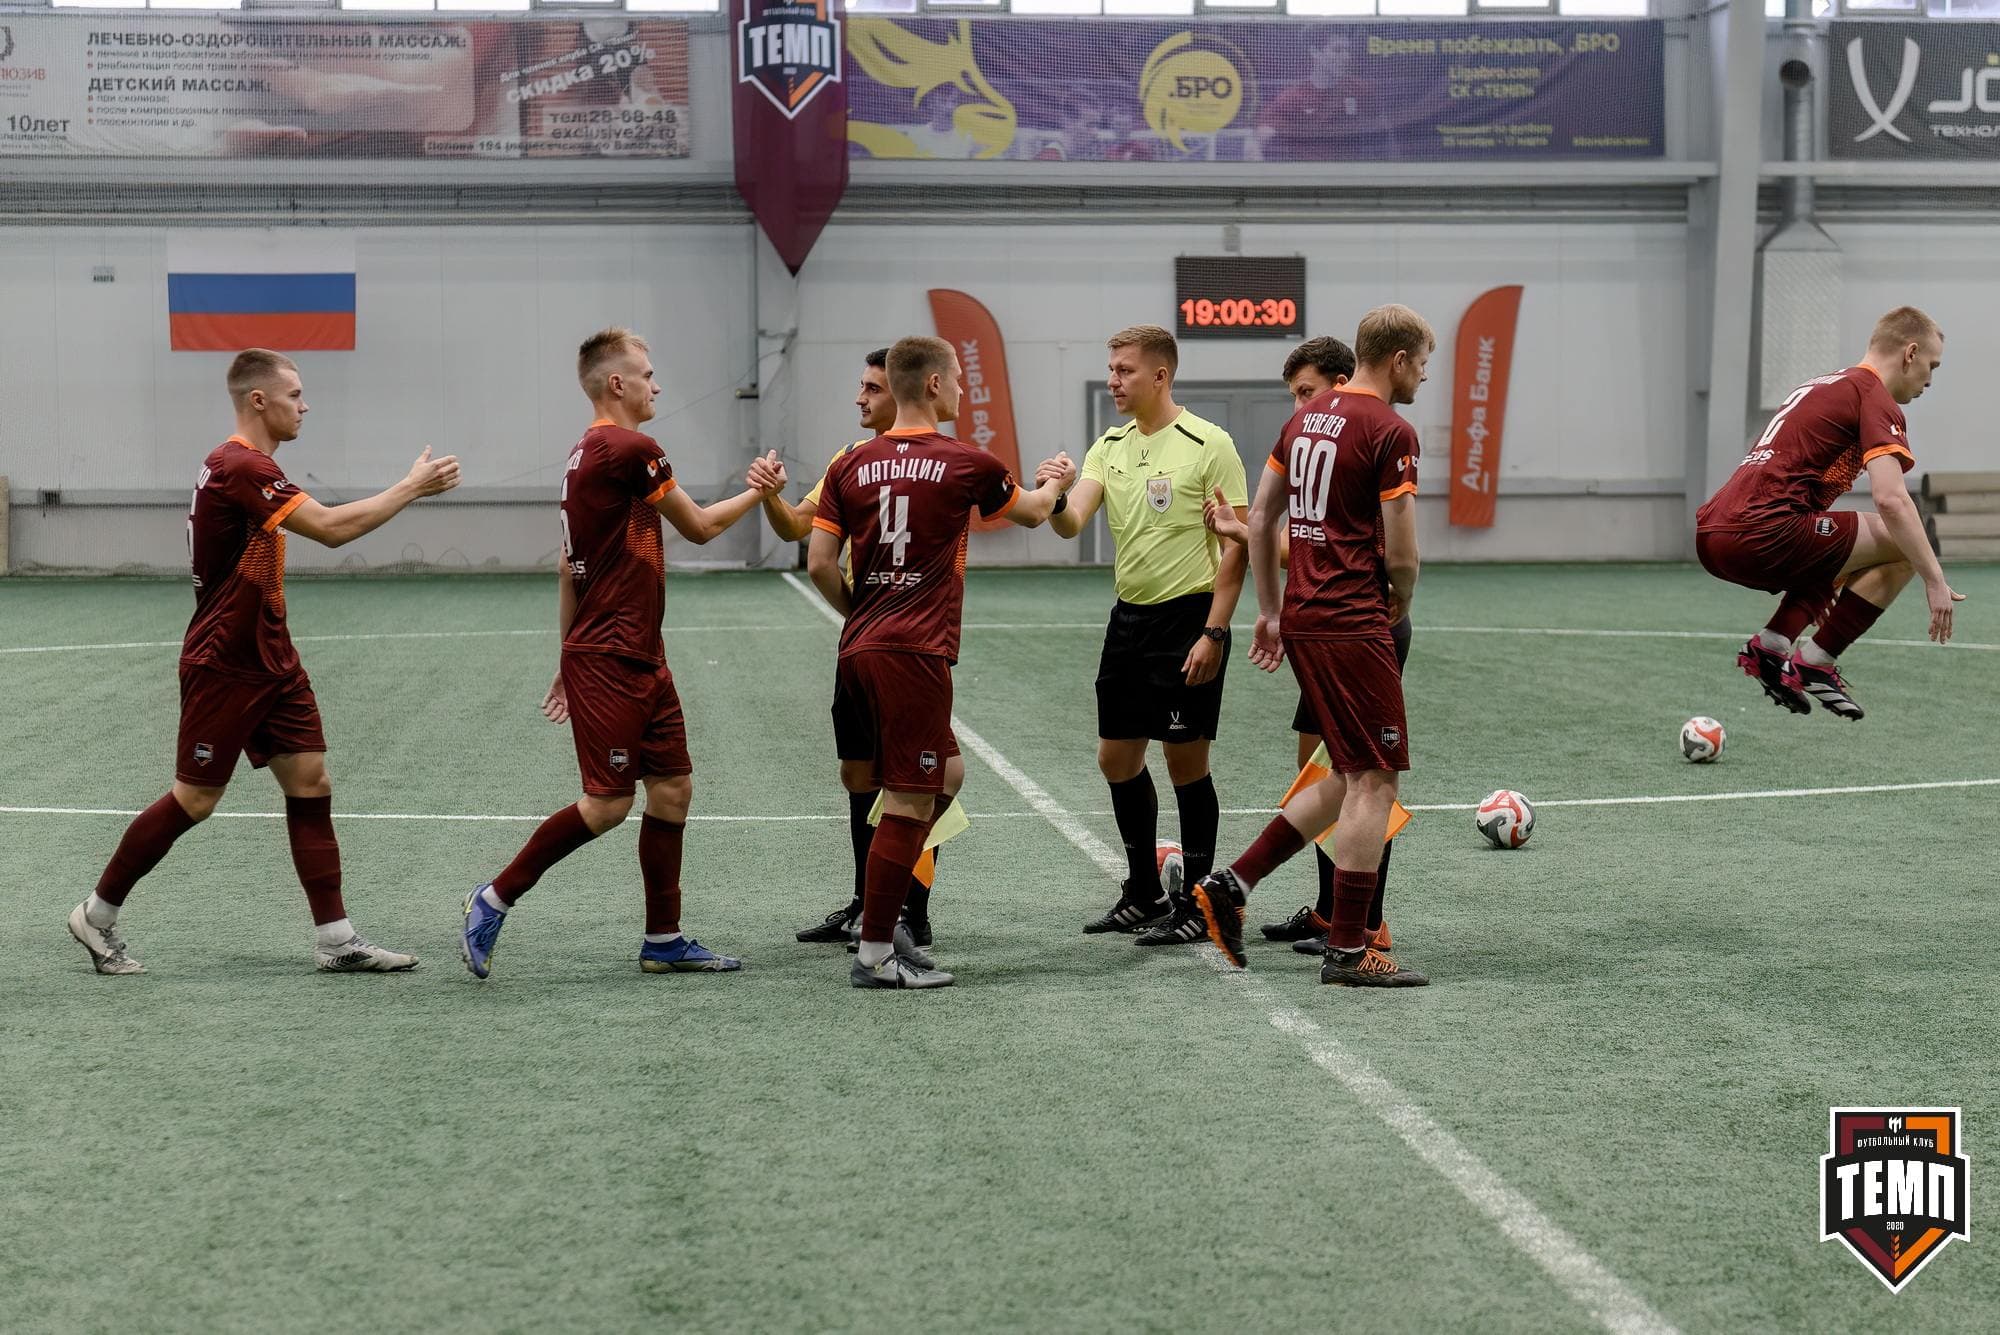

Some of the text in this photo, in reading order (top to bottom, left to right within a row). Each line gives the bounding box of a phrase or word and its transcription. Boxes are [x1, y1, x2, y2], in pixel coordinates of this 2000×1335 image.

[87, 31, 467, 49] ЛЕЧЕБНО-ОЗДОРОВИТЕЛЬНЫЙ МАССАЖ:
[748, 23, 831, 68] ТЕМП
[1367, 36, 1436, 56] Время
[598, 42, 657, 75] 20%
[88, 75, 271, 93] ДЕТСКИЙ МАССАЖ:
[1168, 75, 1233, 99] .БРО
[7, 115, 71, 132] 10лет
[1180, 298, 1296, 326] 19:00:30
[1302, 412, 1347, 438] ЧЕВЕЛЕВ
[1461, 336, 1496, 493] Альфа Банк
[857, 458, 947, 488] МАТЫЦИН
[1289, 436, 1338, 522] 90
[878, 485, 912, 566] 4
